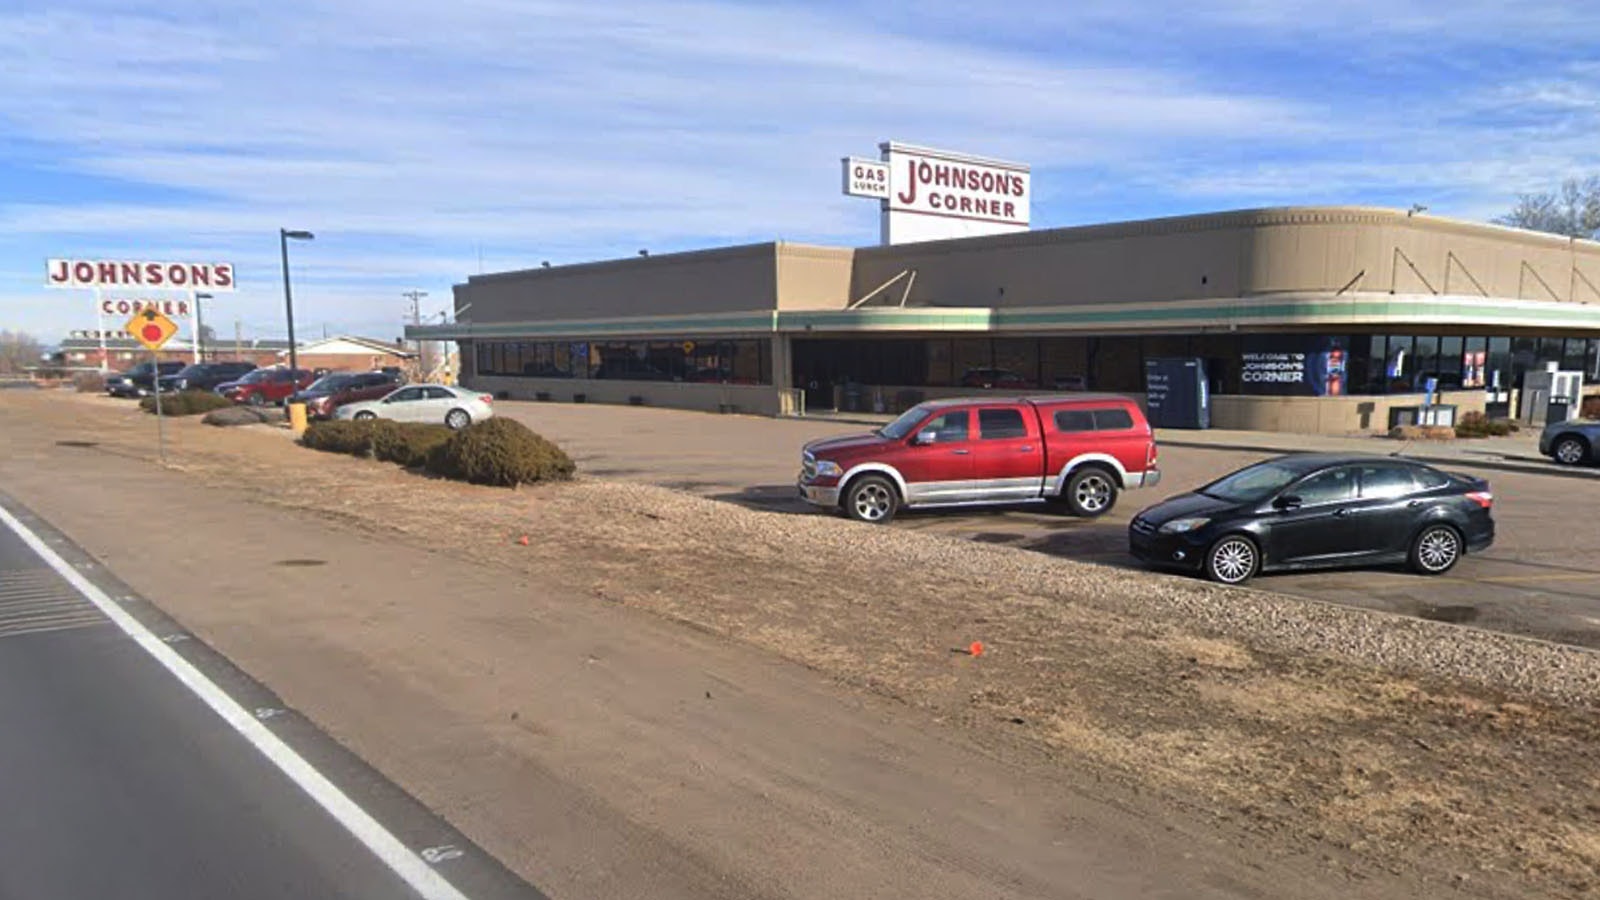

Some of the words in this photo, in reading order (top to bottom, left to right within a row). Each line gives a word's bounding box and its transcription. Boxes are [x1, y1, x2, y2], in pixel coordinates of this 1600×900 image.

[854, 165, 886, 182] GAS
[854, 182, 886, 193] LUNCH
[898, 159, 1024, 205] JOHNSON'S
[928, 192, 1016, 218] CORNER
[51, 262, 231, 286] JOHNSONS
[102, 300, 188, 315] CORER
[1242, 353, 1288, 361] WELCOME
[1291, 353, 1305, 361] TO
[1242, 371, 1304, 383] CORNER
